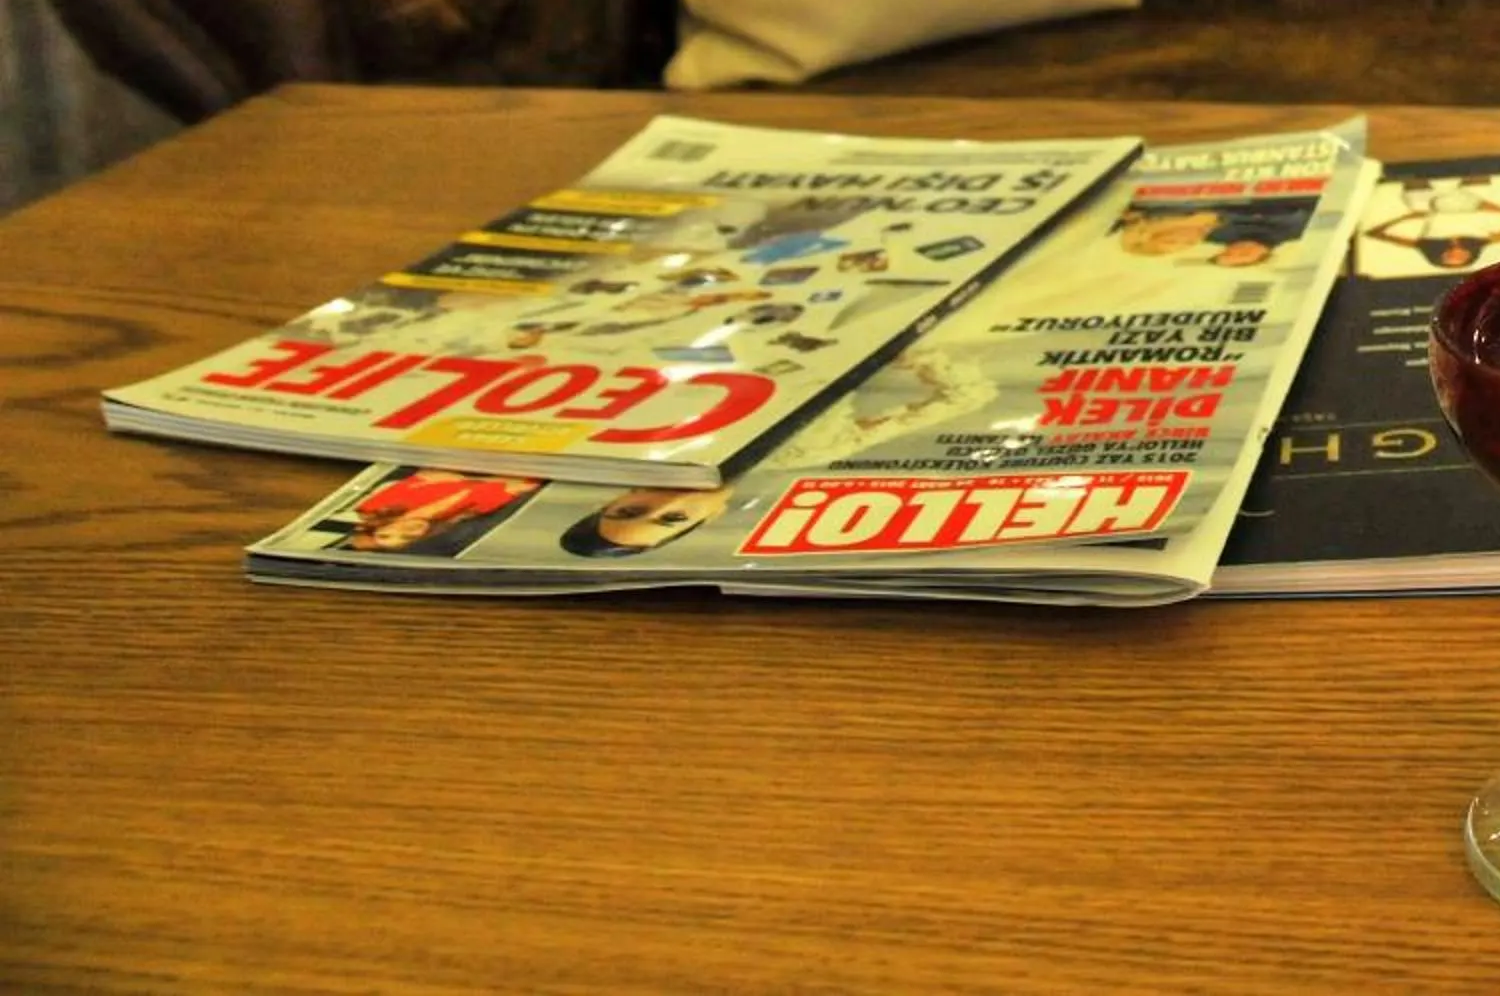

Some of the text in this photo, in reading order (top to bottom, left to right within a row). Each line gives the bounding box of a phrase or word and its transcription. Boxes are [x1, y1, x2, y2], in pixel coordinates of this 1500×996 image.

[1107, 329, 1185, 346] YAZI
[1038, 393, 1224, 428] DİLEK
[758, 485, 1168, 548] HELLO!
